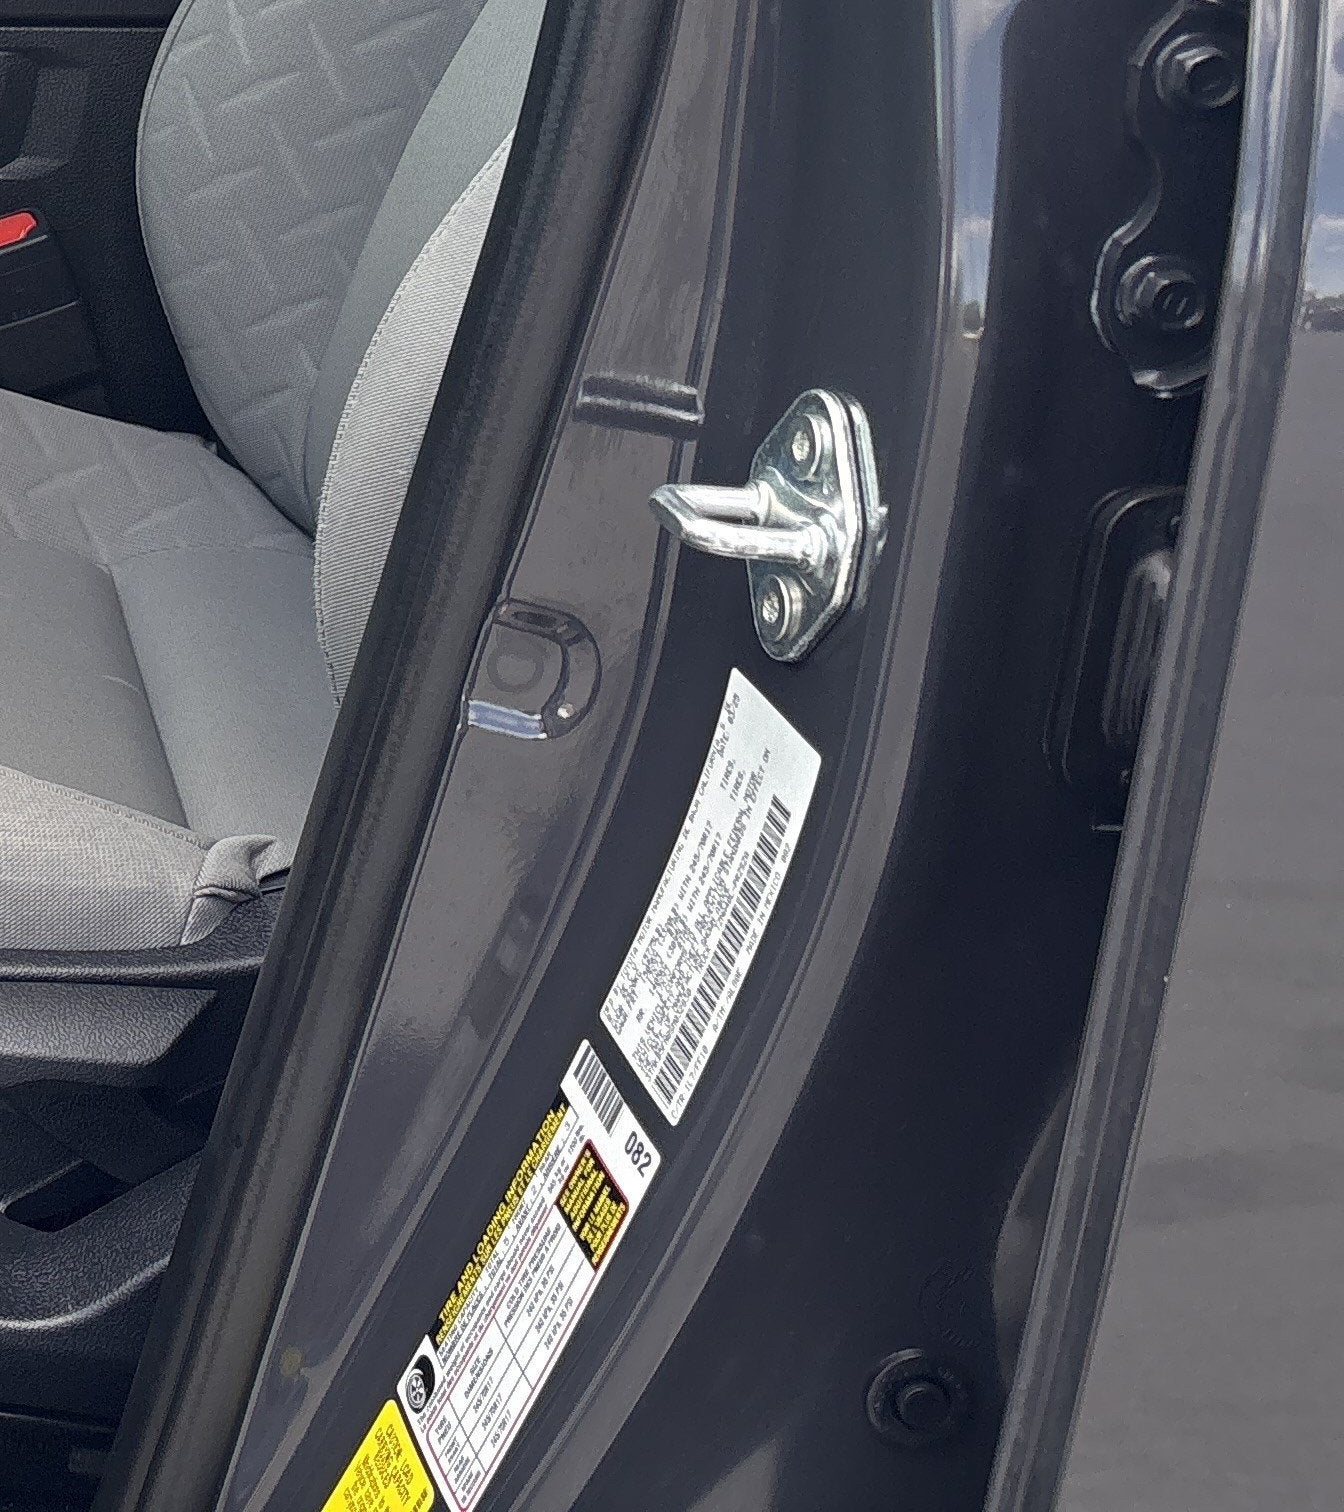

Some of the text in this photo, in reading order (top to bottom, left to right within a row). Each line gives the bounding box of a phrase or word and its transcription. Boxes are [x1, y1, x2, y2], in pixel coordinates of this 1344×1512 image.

[438, 1108, 556, 1325] TIRE AND LOADING INFORMATION
[624, 1130, 652, 1178] 082
